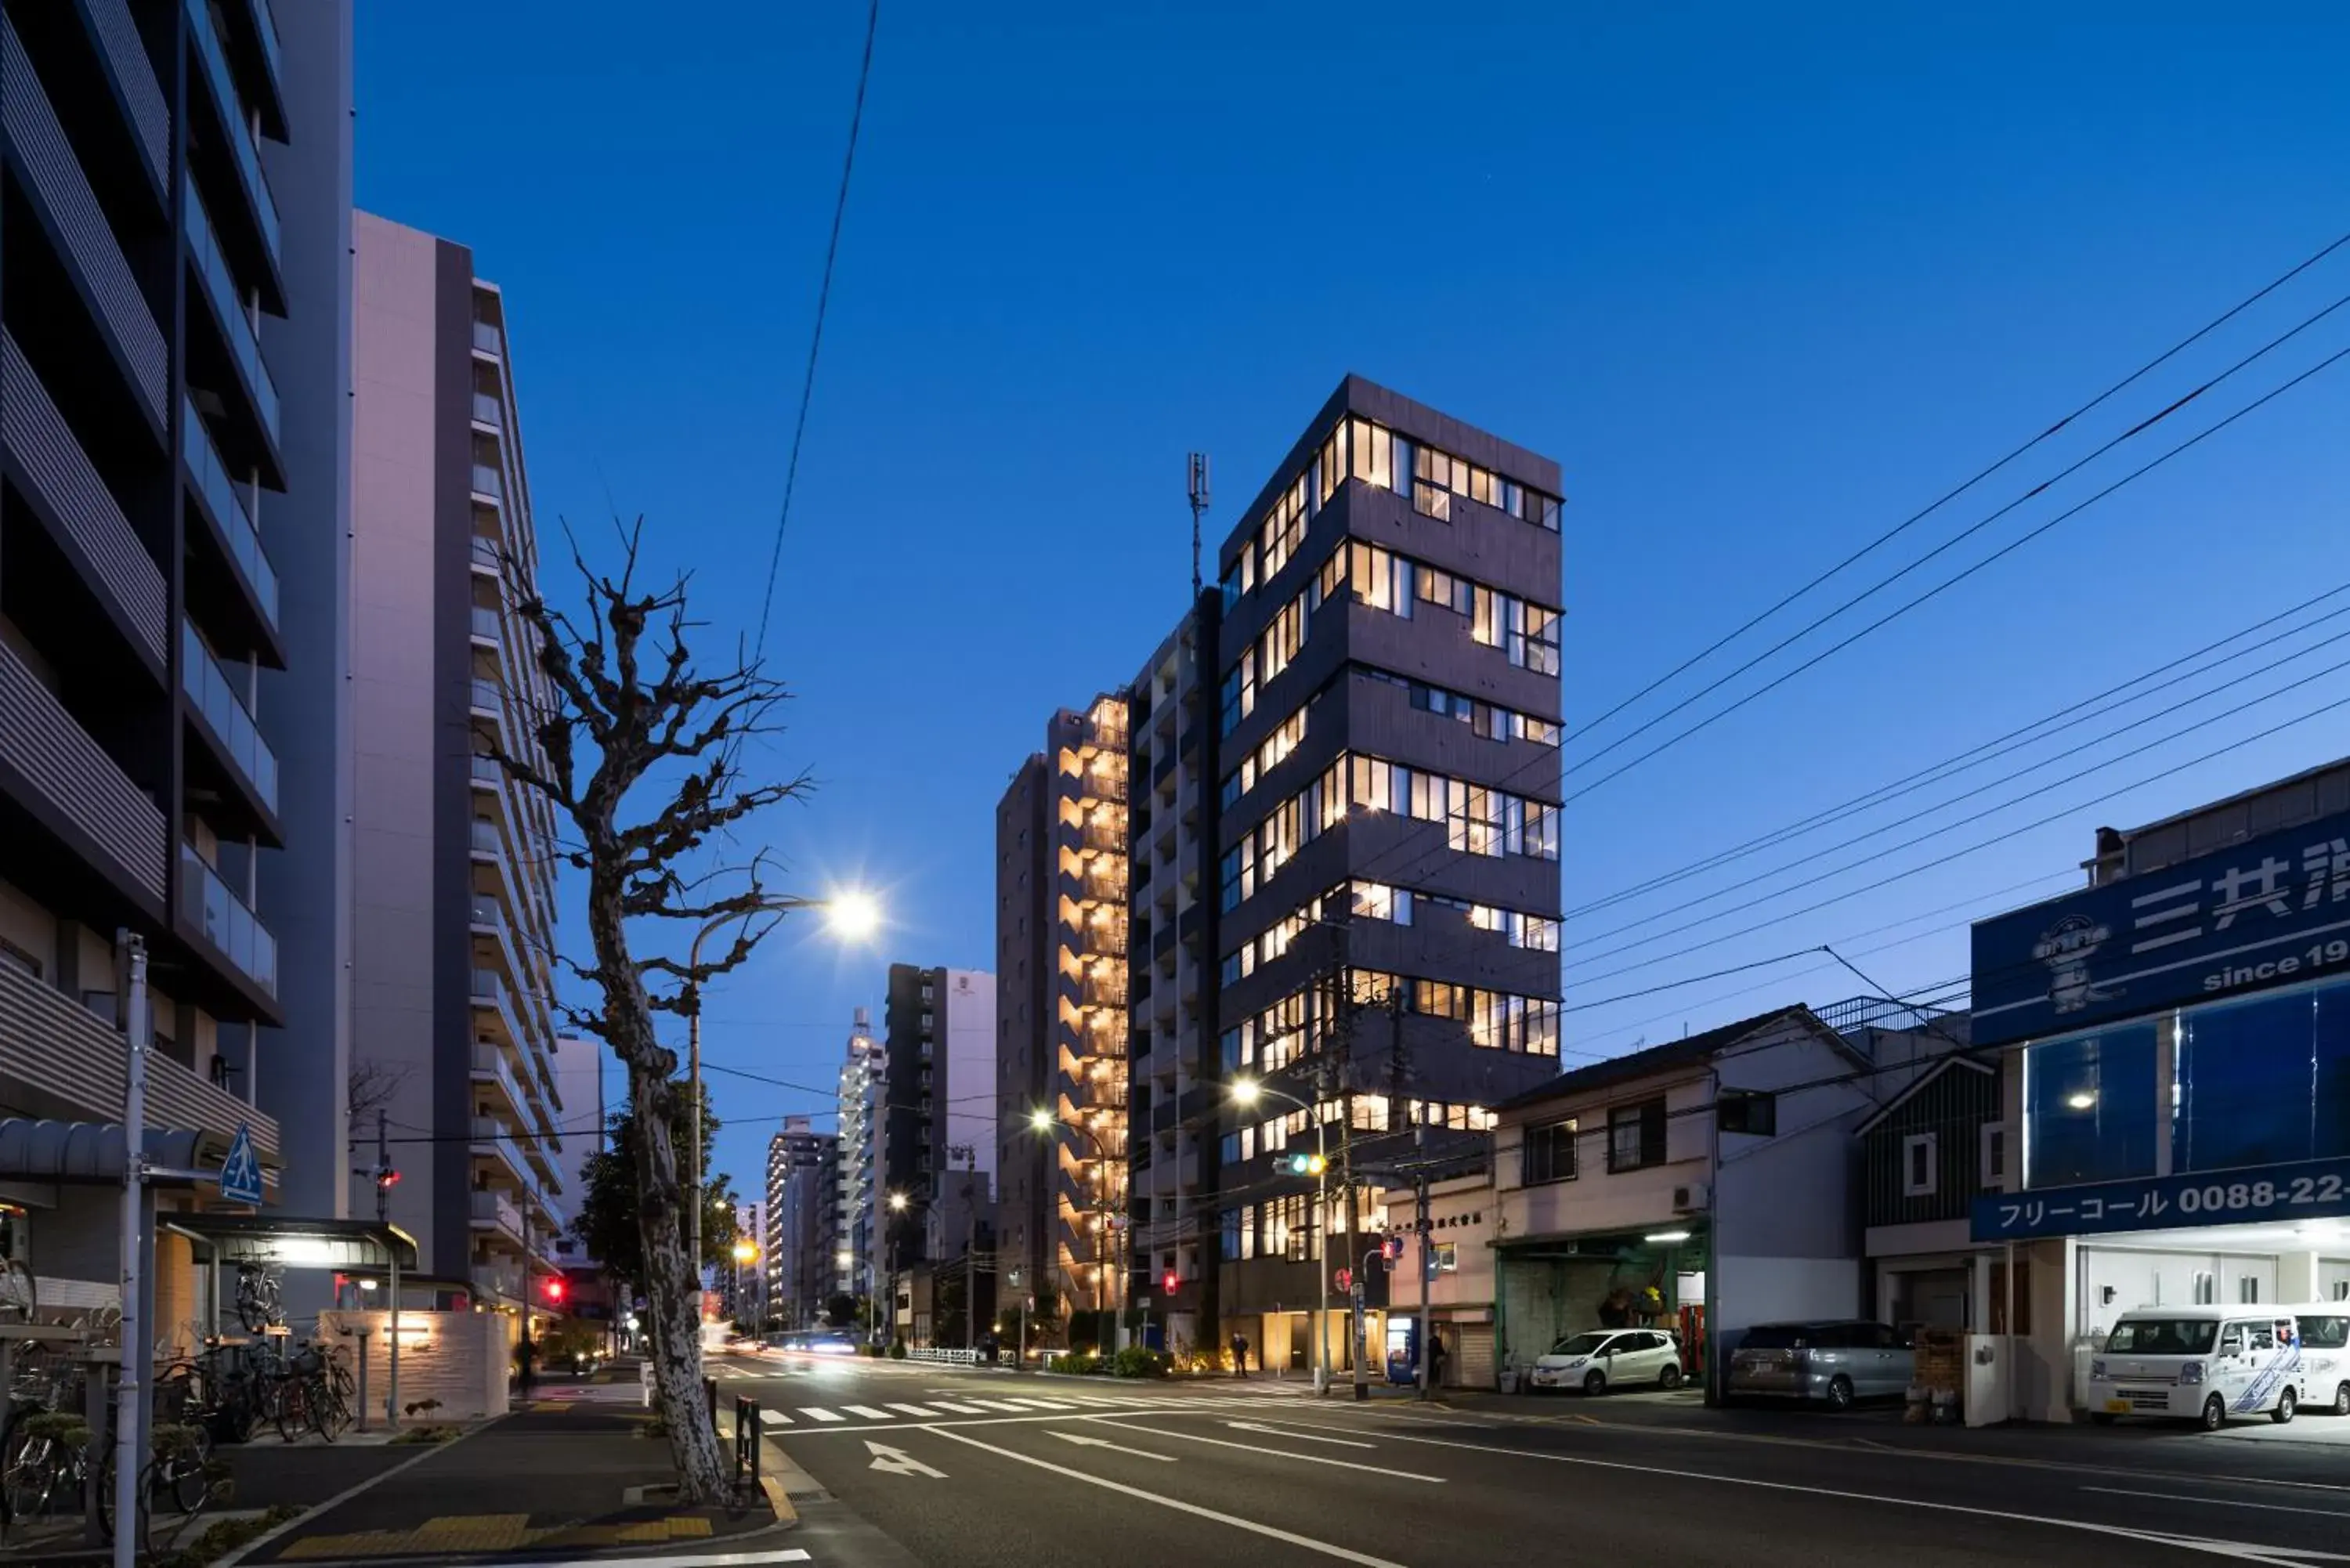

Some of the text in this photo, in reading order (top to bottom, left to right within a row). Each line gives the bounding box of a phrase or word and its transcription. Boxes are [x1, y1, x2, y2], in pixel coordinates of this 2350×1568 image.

[2204, 939, 2348, 991] since 19
[1999, 1190, 2168, 1228] フリーコール
